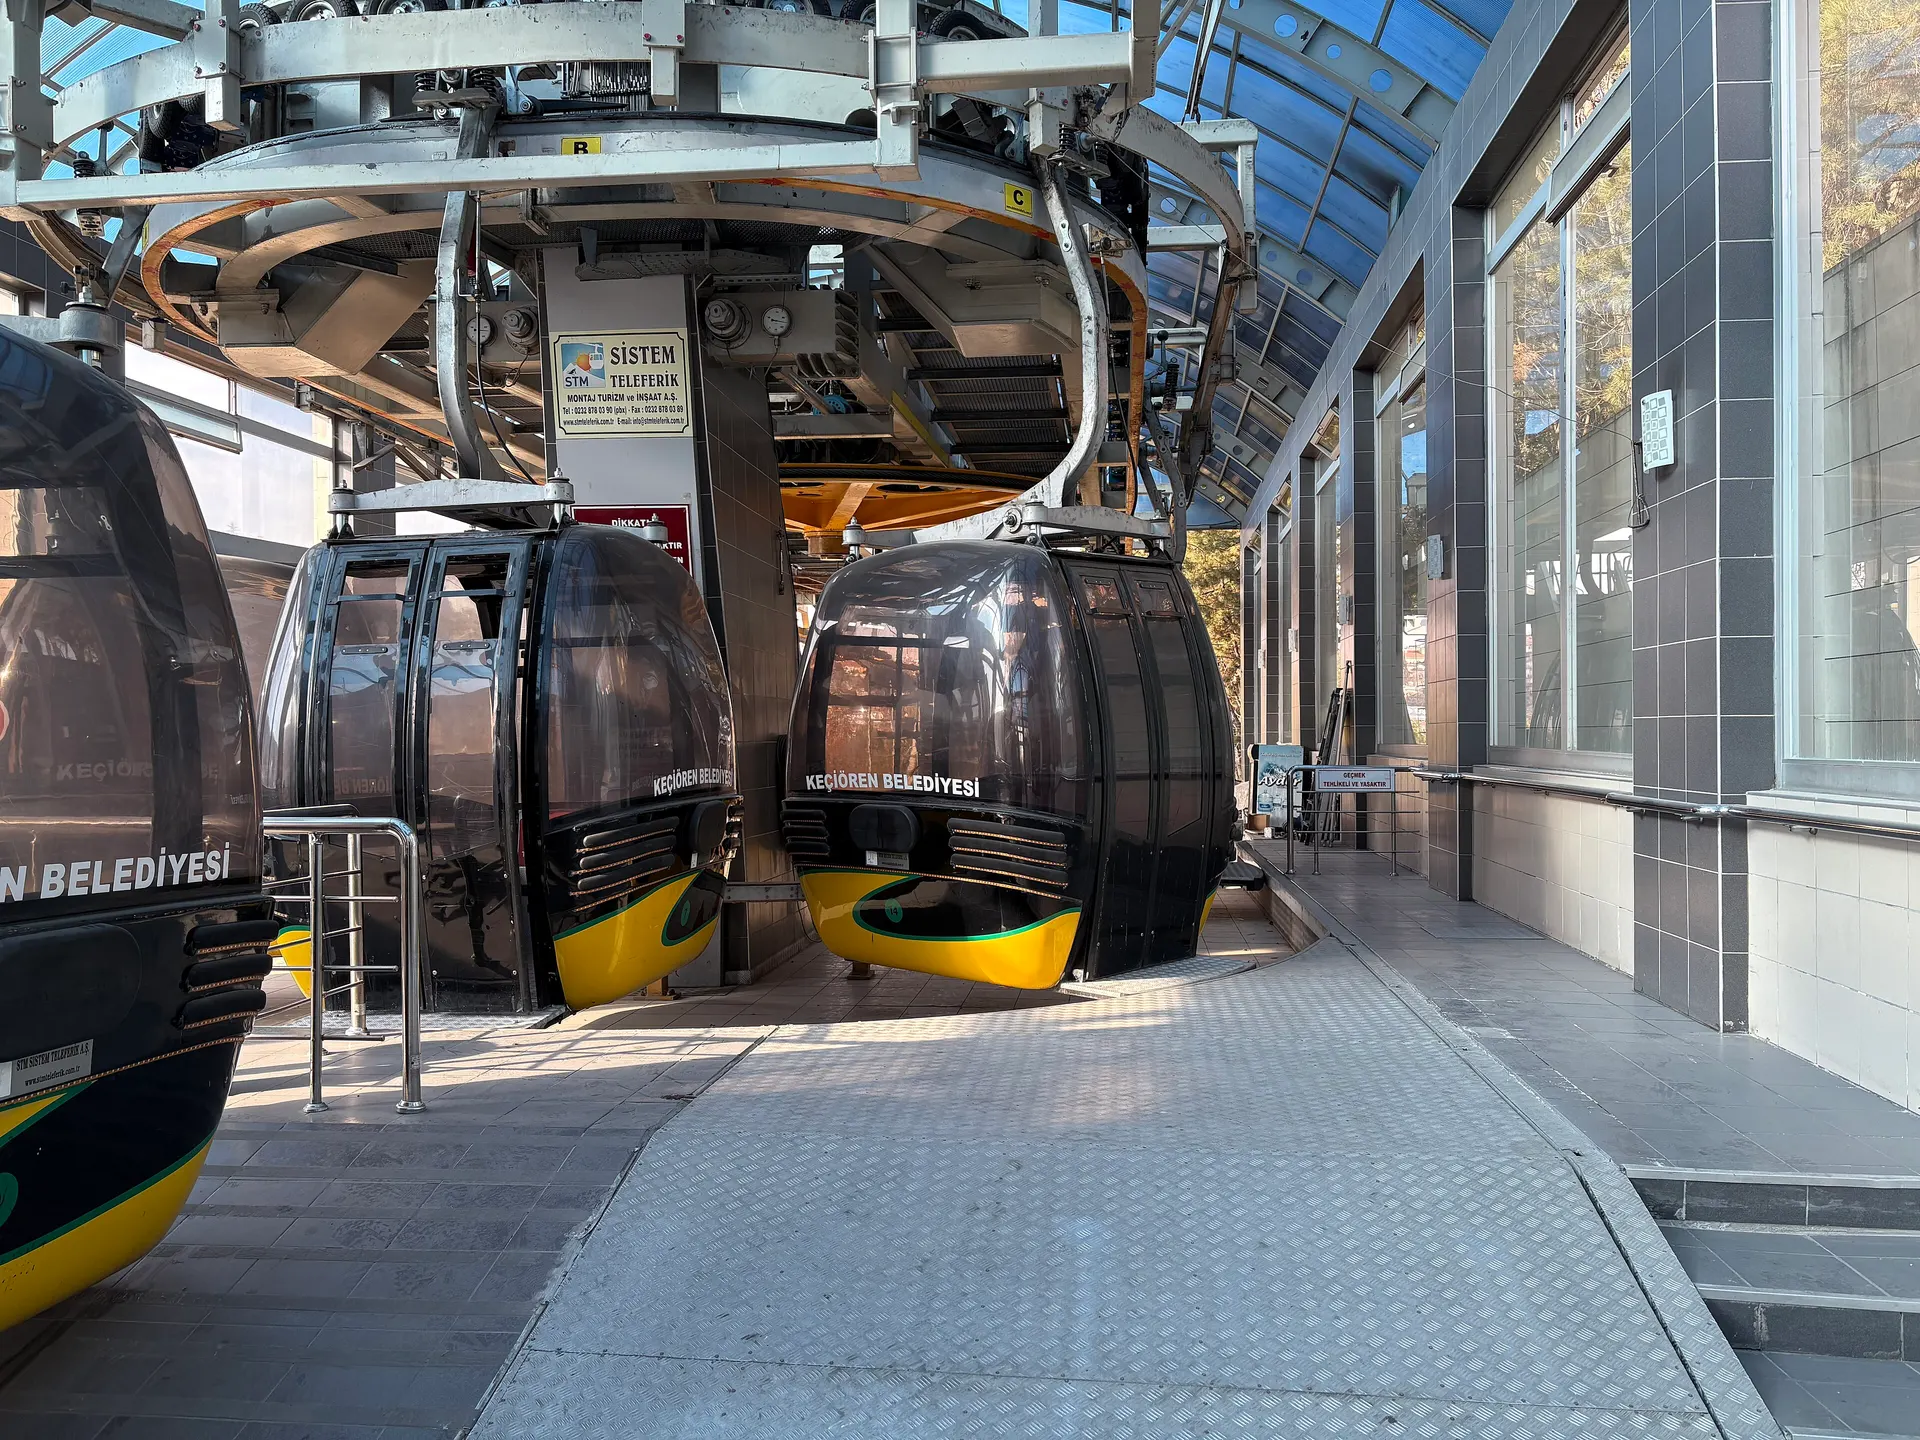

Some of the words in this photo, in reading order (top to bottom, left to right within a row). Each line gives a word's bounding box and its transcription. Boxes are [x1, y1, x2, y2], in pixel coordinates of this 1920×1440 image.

[1013, 189, 1024, 205] C
[610, 341, 676, 365] SİSTEM
[565, 376, 589, 387] STM
[610, 370, 679, 387] TELEFERİK
[567, 394, 595, 403] MONTAJ
[599, 392, 625, 402] TURİZM
[636, 391, 662, 403] İNŞAAT
[664, 392, 678, 403] A.Ş.
[574, 406, 587, 414] 0232
[588, 406, 597, 414] 878
[599, 406, 605, 414] 03
[645, 405, 657, 413] 0232
[659, 405, 668, 413] 878
[669, 405, 676, 413] 03
[677, 405, 684, 413] 89
[653, 768, 698, 797] KEÇİÖREN
[806, 770, 879, 792] KEÇİÖREN
[882, 773, 980, 798] BELEDİYESİ
[1258, 775, 1302, 787] Aydr
[40, 841, 230, 899] BELEDİYESİ
